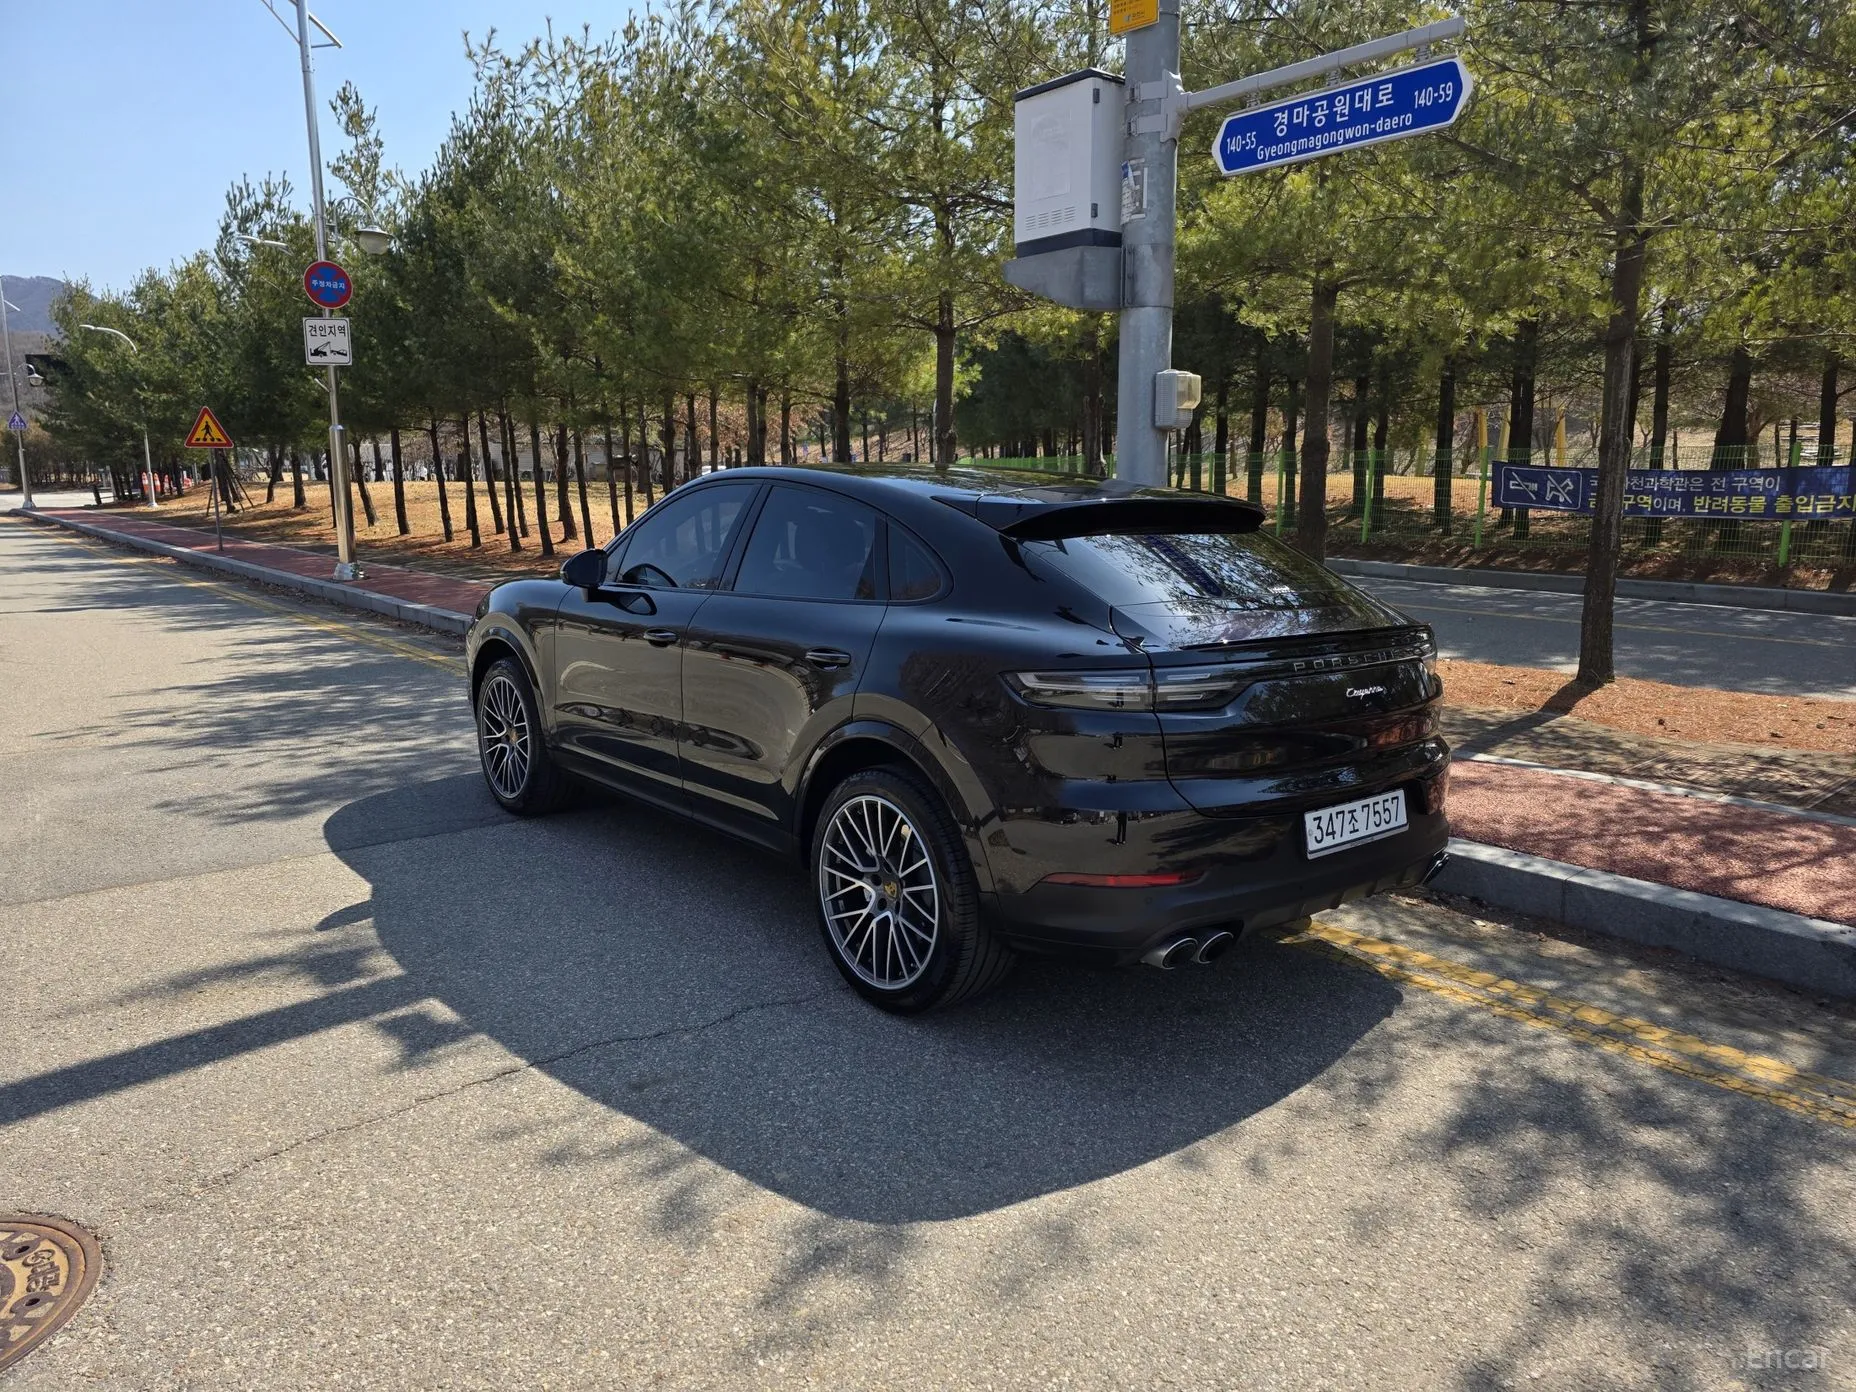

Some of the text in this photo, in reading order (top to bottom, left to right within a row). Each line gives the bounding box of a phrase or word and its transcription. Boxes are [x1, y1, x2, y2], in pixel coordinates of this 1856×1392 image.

[1413, 81, 1453, 109] 140-59
[1273, 82, 1394, 137] 경마공원대로
[1226, 131, 1257, 155] 140-55
[1257, 112, 1413, 161] Gyeongmagongwon-daero
[308, 324, 346, 337] 견인지역
[1711, 476, 1726, 492] 전
[1732, 475, 1781, 492] 구역이
[1693, 495, 1767, 514] 반려동물
